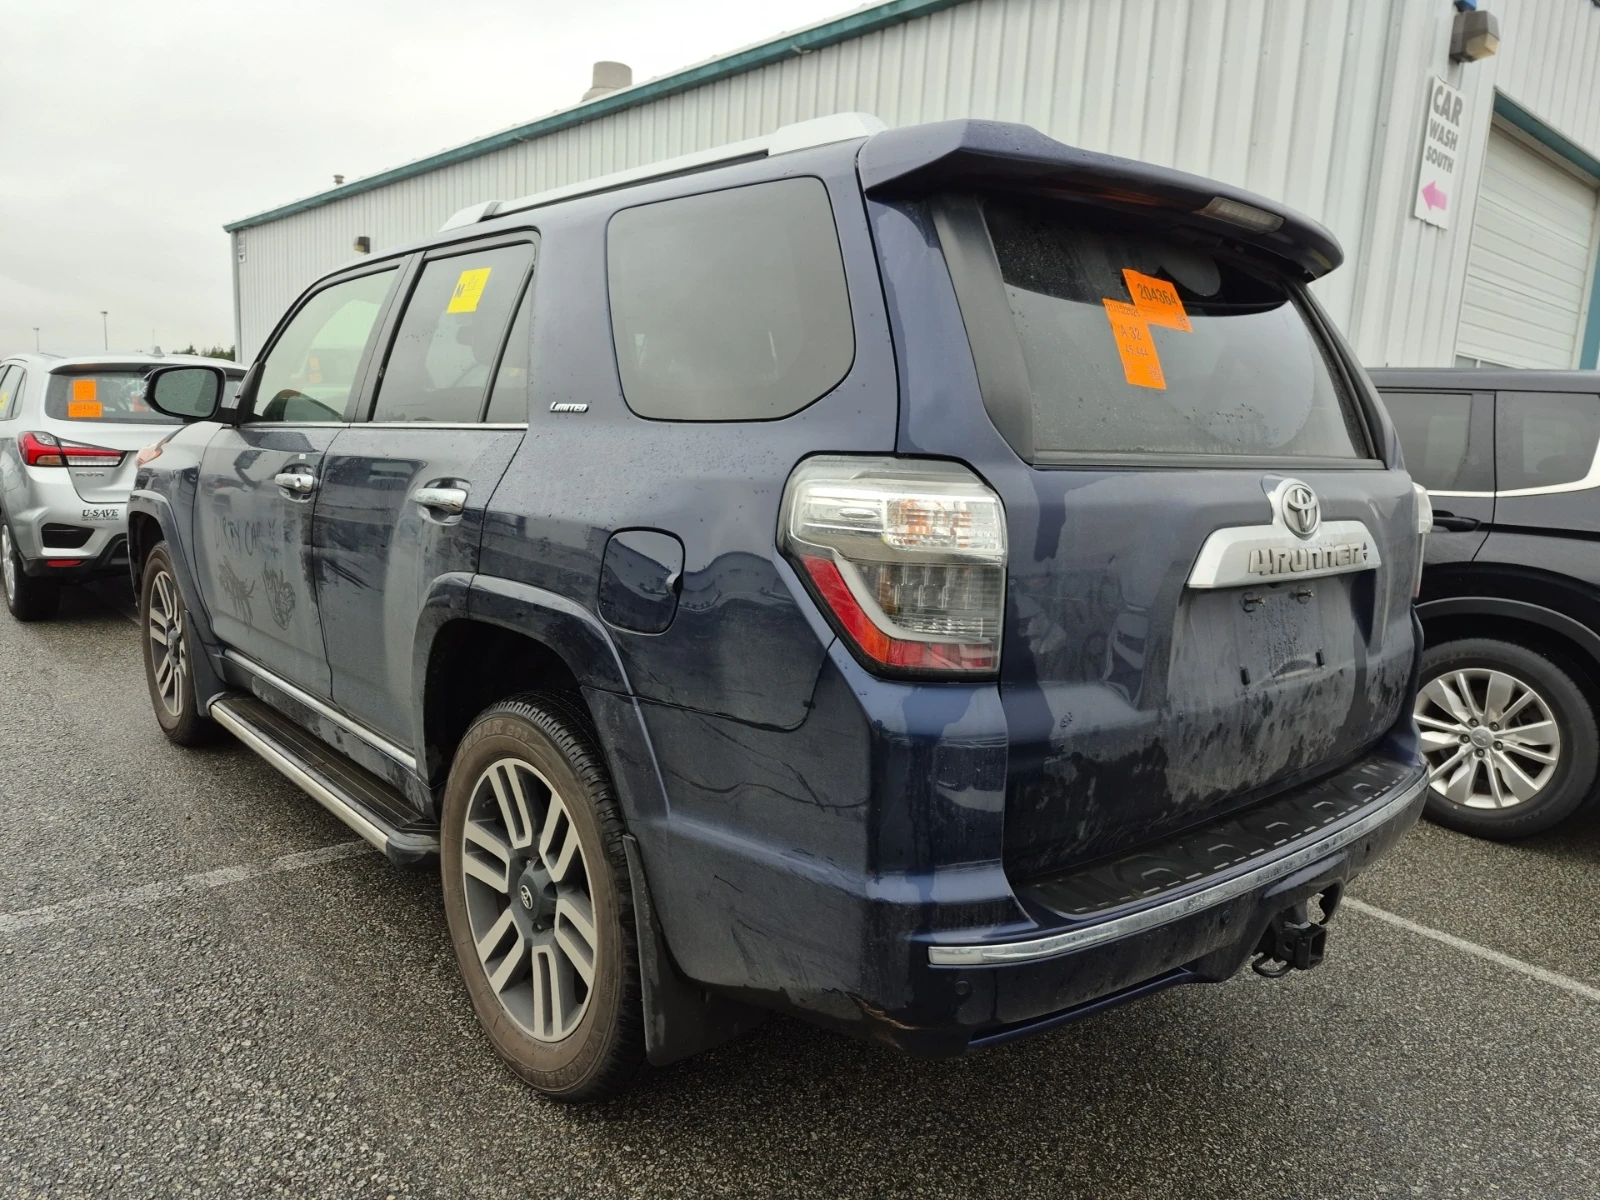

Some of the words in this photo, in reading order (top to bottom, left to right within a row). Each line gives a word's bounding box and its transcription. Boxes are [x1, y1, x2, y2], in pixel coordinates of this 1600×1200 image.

[1433, 85, 1463, 127] CAR
[1429, 118, 1459, 151] WASH
[1425, 145, 1454, 173] SOUTH
[1136, 283, 1179, 308] 204364
[1120, 324, 1128, 338] A
[1129, 326, 1143, 341] 32
[82, 508, 119, 518] U-SAVE
